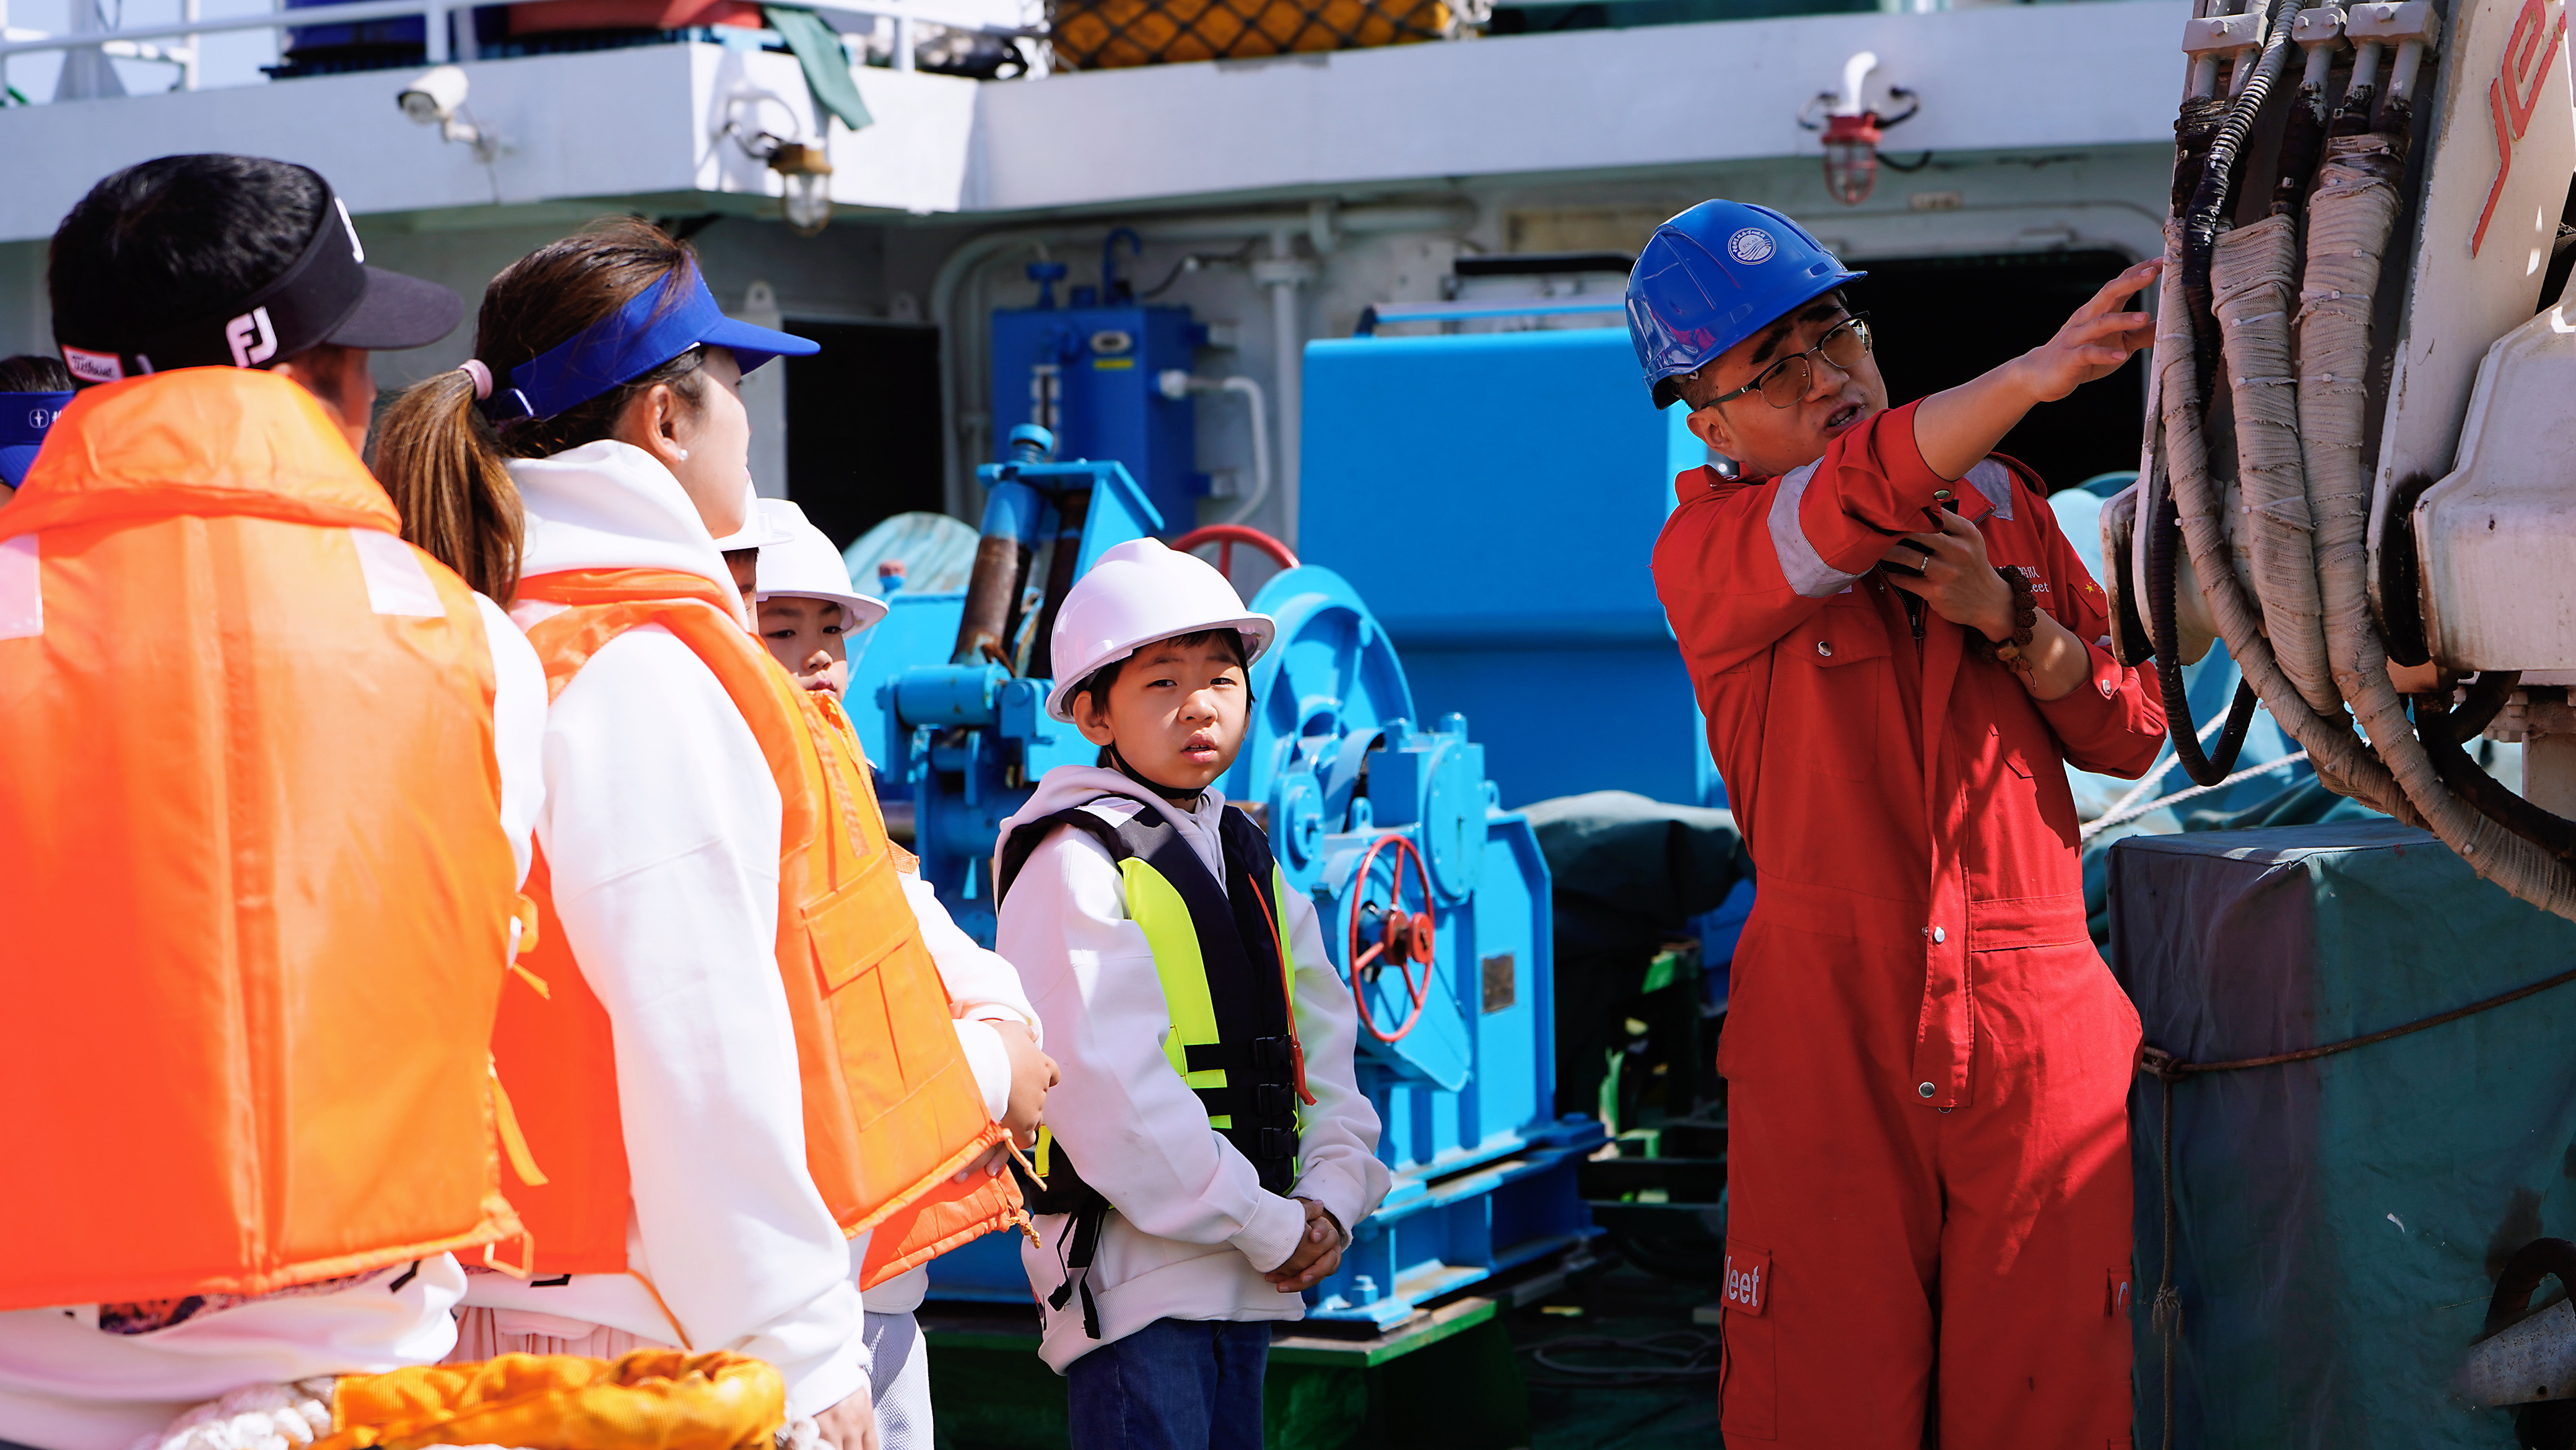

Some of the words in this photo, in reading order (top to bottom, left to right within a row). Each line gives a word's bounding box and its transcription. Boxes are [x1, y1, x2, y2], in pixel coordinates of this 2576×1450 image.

[1742, 237, 1759, 249] IOCAS
[225, 305, 278, 369] FJ
[2030, 582, 2050, 593] eet
[1724, 1254, 1760, 1307] leet
